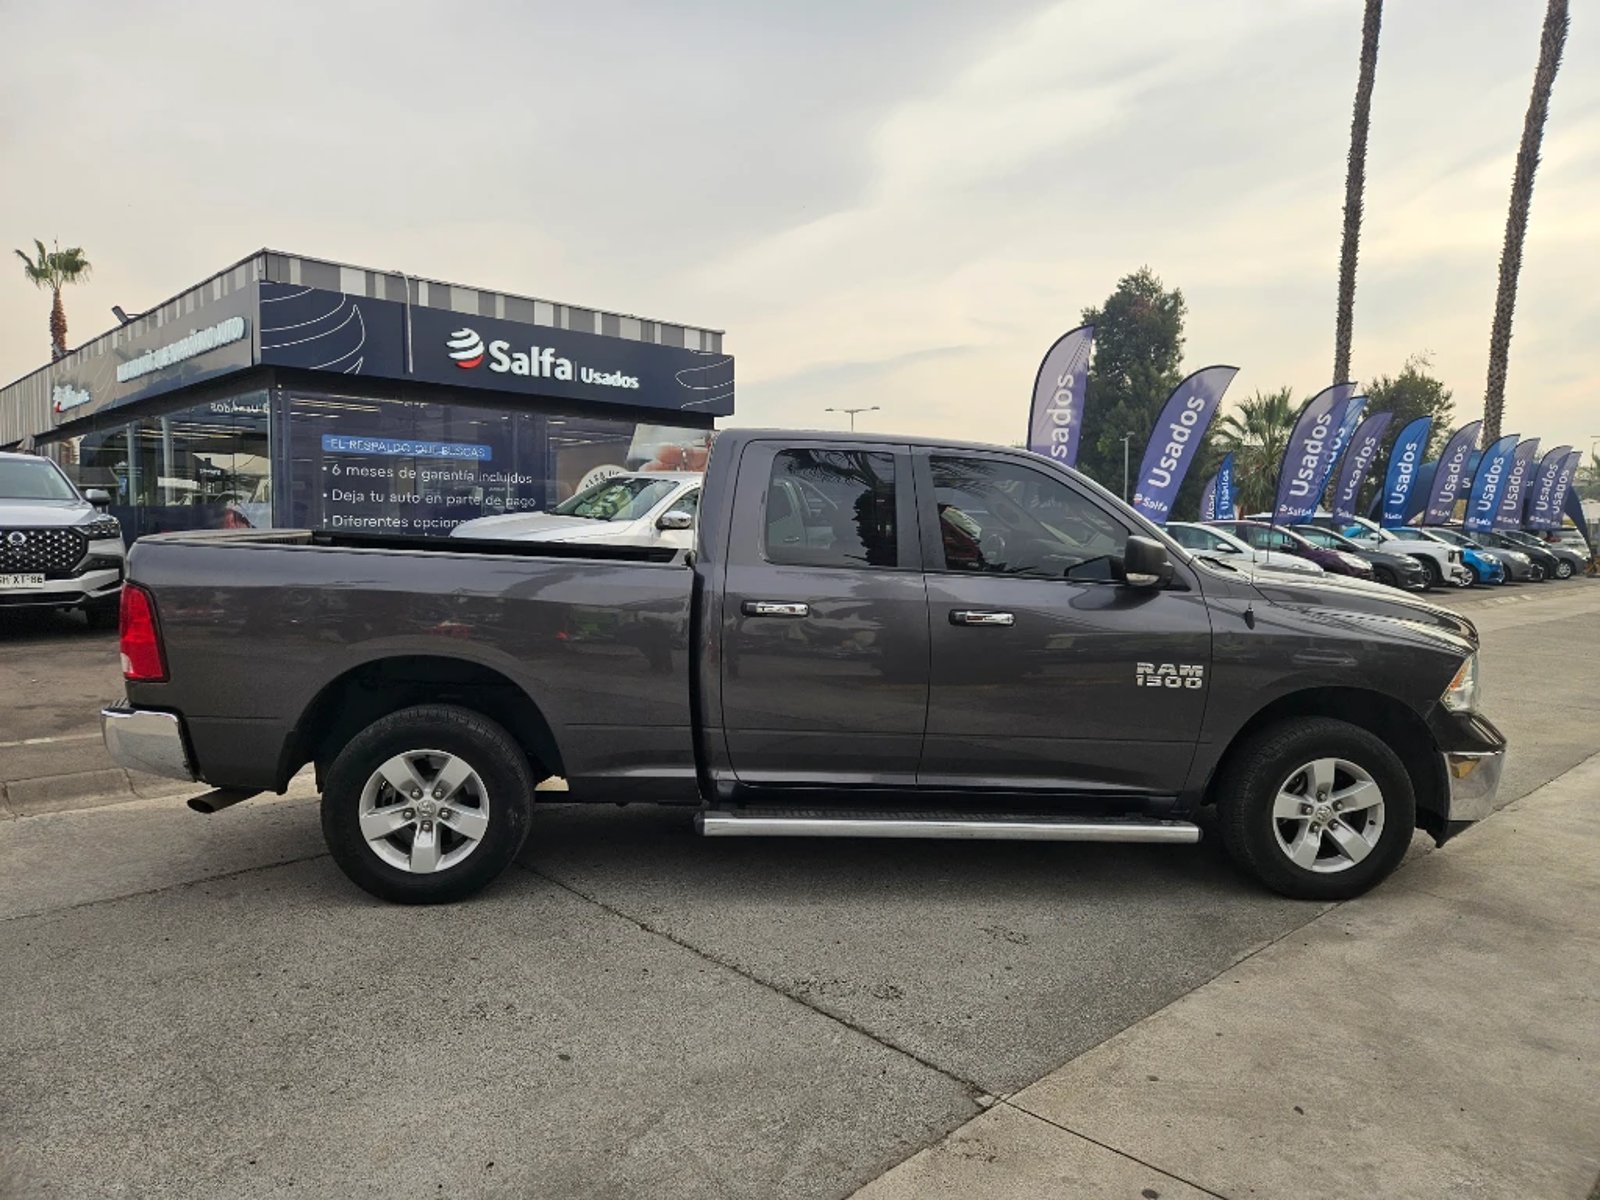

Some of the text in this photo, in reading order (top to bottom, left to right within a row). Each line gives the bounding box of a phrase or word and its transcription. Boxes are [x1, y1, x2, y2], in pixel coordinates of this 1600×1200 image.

[488, 340, 640, 389] Salfa Usados
[330, 438, 346, 450] EL
[1148, 395, 1205, 489] Usados
[1288, 413, 1332, 497] Usados
[331, 463, 341, 476] 6
[346, 466, 394, 478] meses
[398, 467, 417, 479] de
[1342, 436, 1376, 501] Usados
[1389, 442, 1418, 505] Usados
[1438, 444, 1468, 503] Usados
[1476, 456, 1505, 512] Usados
[1502, 458, 1526, 511] Usados
[1535, 463, 1559, 511] Usados
[332, 488, 537, 509] Deja tu auto en parte de pago
[332, 514, 409, 528] Diferentes
[1142, 496, 1168, 512] Salfa
[1136, 661, 1204, 677] RAM
[1136, 674, 1203, 689] 1500
